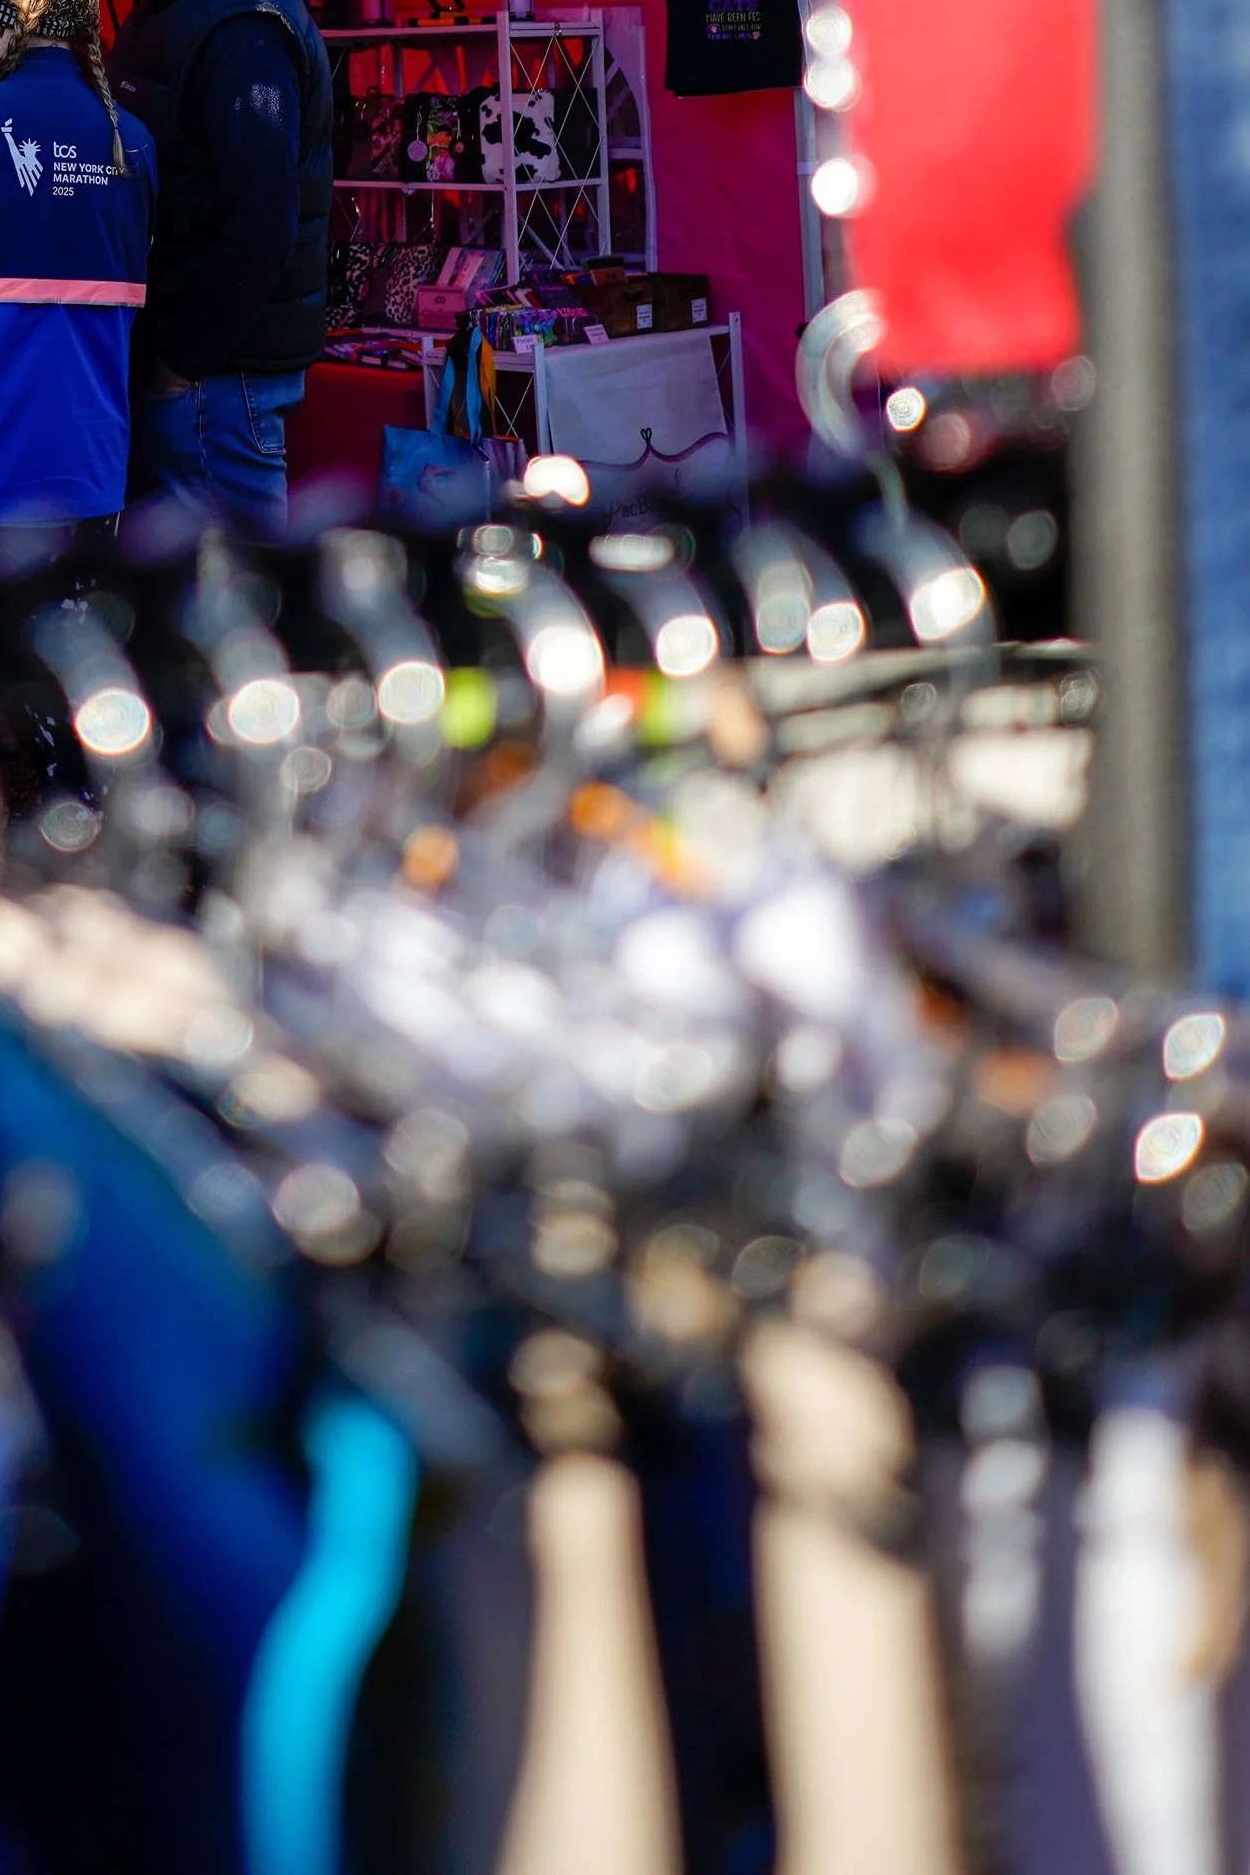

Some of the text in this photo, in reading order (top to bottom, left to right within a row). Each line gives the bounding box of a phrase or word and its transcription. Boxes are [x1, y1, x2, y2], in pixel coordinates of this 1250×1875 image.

[706, 13, 724, 23] HAVE
[728, 12, 746, 22] BEEN
[53, 141, 77, 159] tcs
[53, 162, 77, 172] NEW
[80, 163, 104, 174] YORK
[53, 174, 108, 186] MARATHON
[52, 187, 74, 196] 2025
